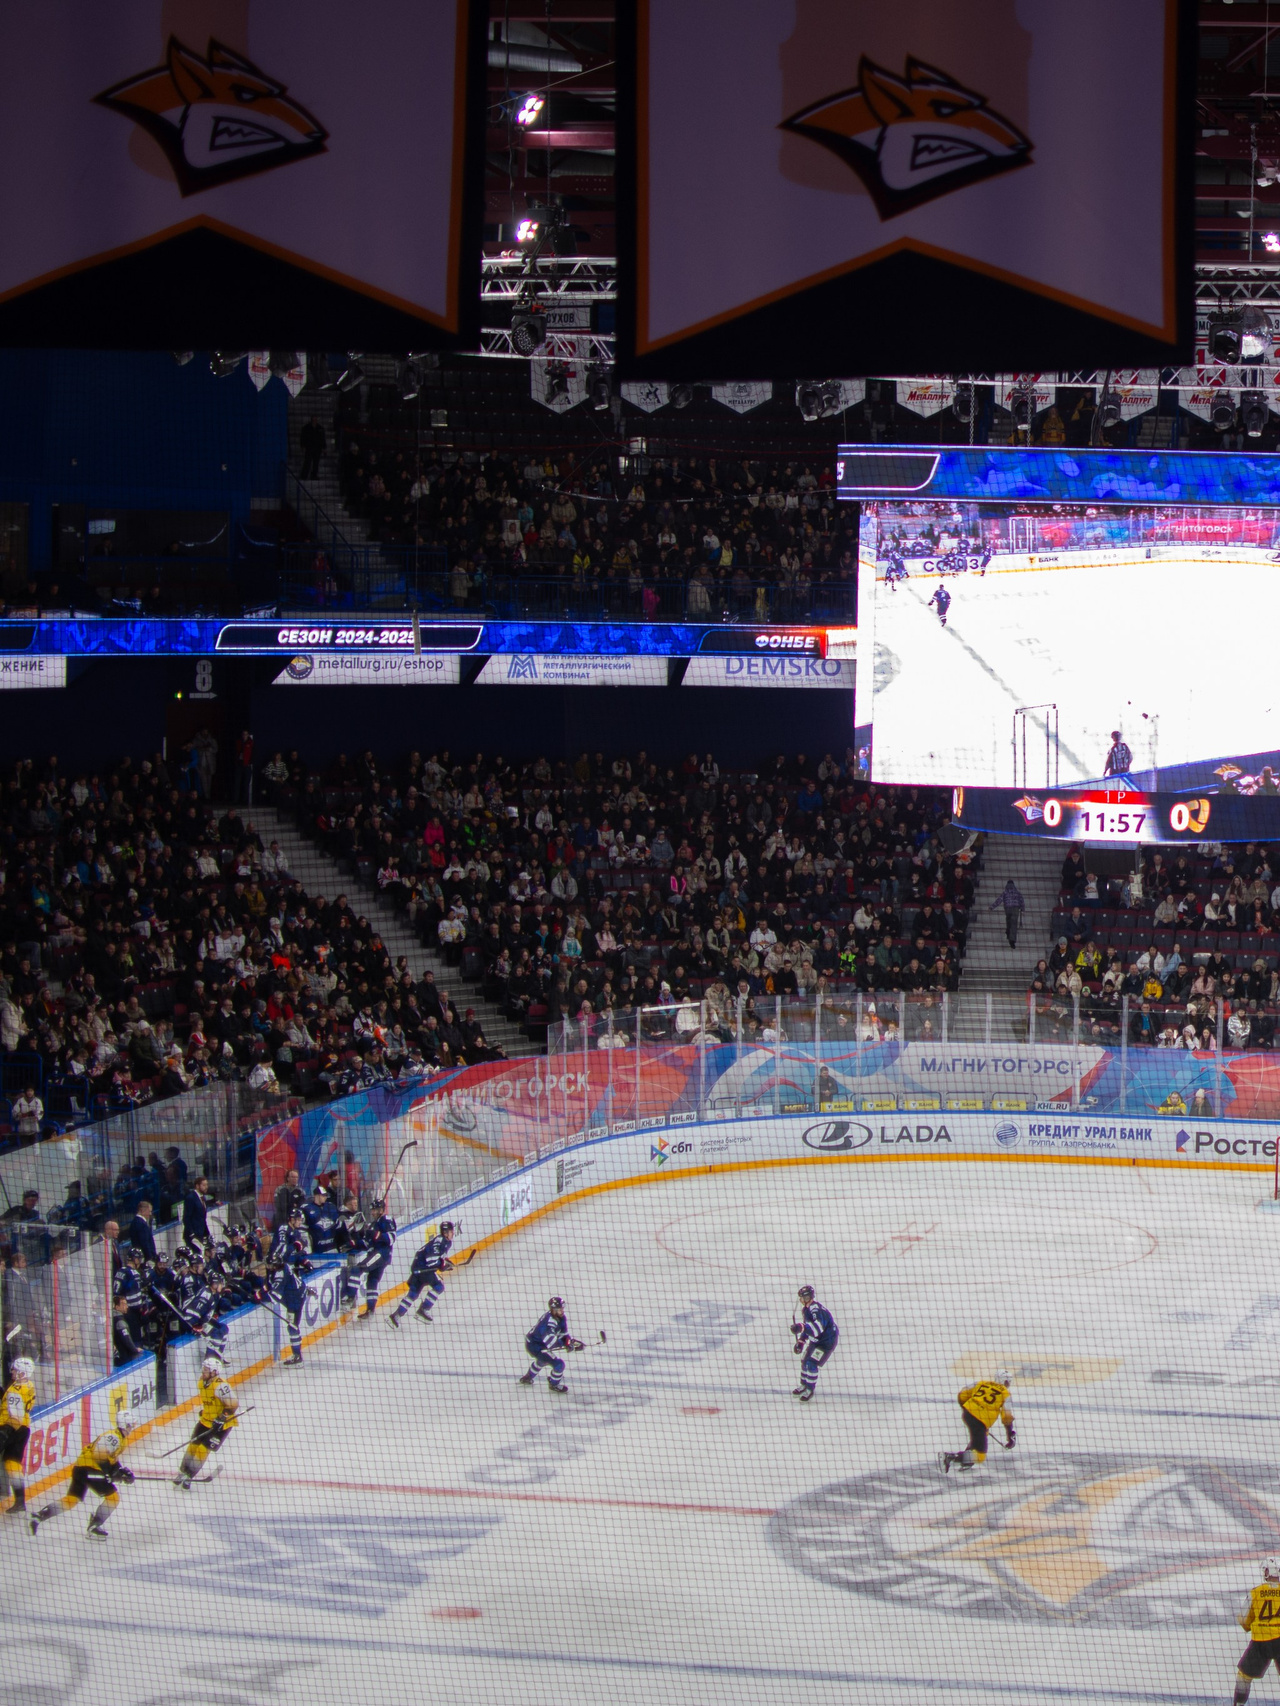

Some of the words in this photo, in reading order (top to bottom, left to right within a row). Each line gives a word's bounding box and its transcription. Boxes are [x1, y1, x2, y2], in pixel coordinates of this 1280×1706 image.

[907, 391, 950, 401] МЕТАЛЛУРГ
[277, 629, 333, 644] СЕЗОН
[335, 629, 415, 645] 2024-2025
[755, 635, 816, 649] ФОНБЕ
[318, 657, 444, 672] metallurg.ru/eshop
[543, 662, 631, 670] МЕТАЛЛУРГИЧЕСКИЙ
[725, 657, 841, 676] DEMSKO
[195, 659, 213, 692] 8
[543, 672, 590, 680] КОМБИНАТ
[1043, 799, 1062, 827] 0
[1170, 802, 1190, 831] 0
[1080, 812, 1146, 834] 11:57
[425, 1070, 592, 1107] МАГНИТОГОРСК
[1037, 1102, 1068, 1111] KHL.RU
[641, 1117, 664, 1128] KHL.RU
[671, 1114, 695, 1123] KHL.RU
[589, 1127, 608, 1139] KHL.RU
[614, 1122, 634, 1132] KHL.RU
[1028, 1124, 1080, 1138] КРЕДИТ
[1085, 1126, 1116, 1140] УРАЛ
[1120, 1127, 1152, 1141] БАНК
[880, 1125, 952, 1143] LADA
[725, 1136, 752, 1145] быстрых
[1028, 1139, 1055, 1147] ГРУППА
[1061, 1140, 1116, 1150] ГАЗПРОМБАНКА
[671, 1143, 692, 1154] сбп
[219, 1385, 231, 1397] 12
[973, 1384, 1002, 1405] 53
[8, 1396, 20, 1406] 97
[106, 1434, 118, 1447] 99
